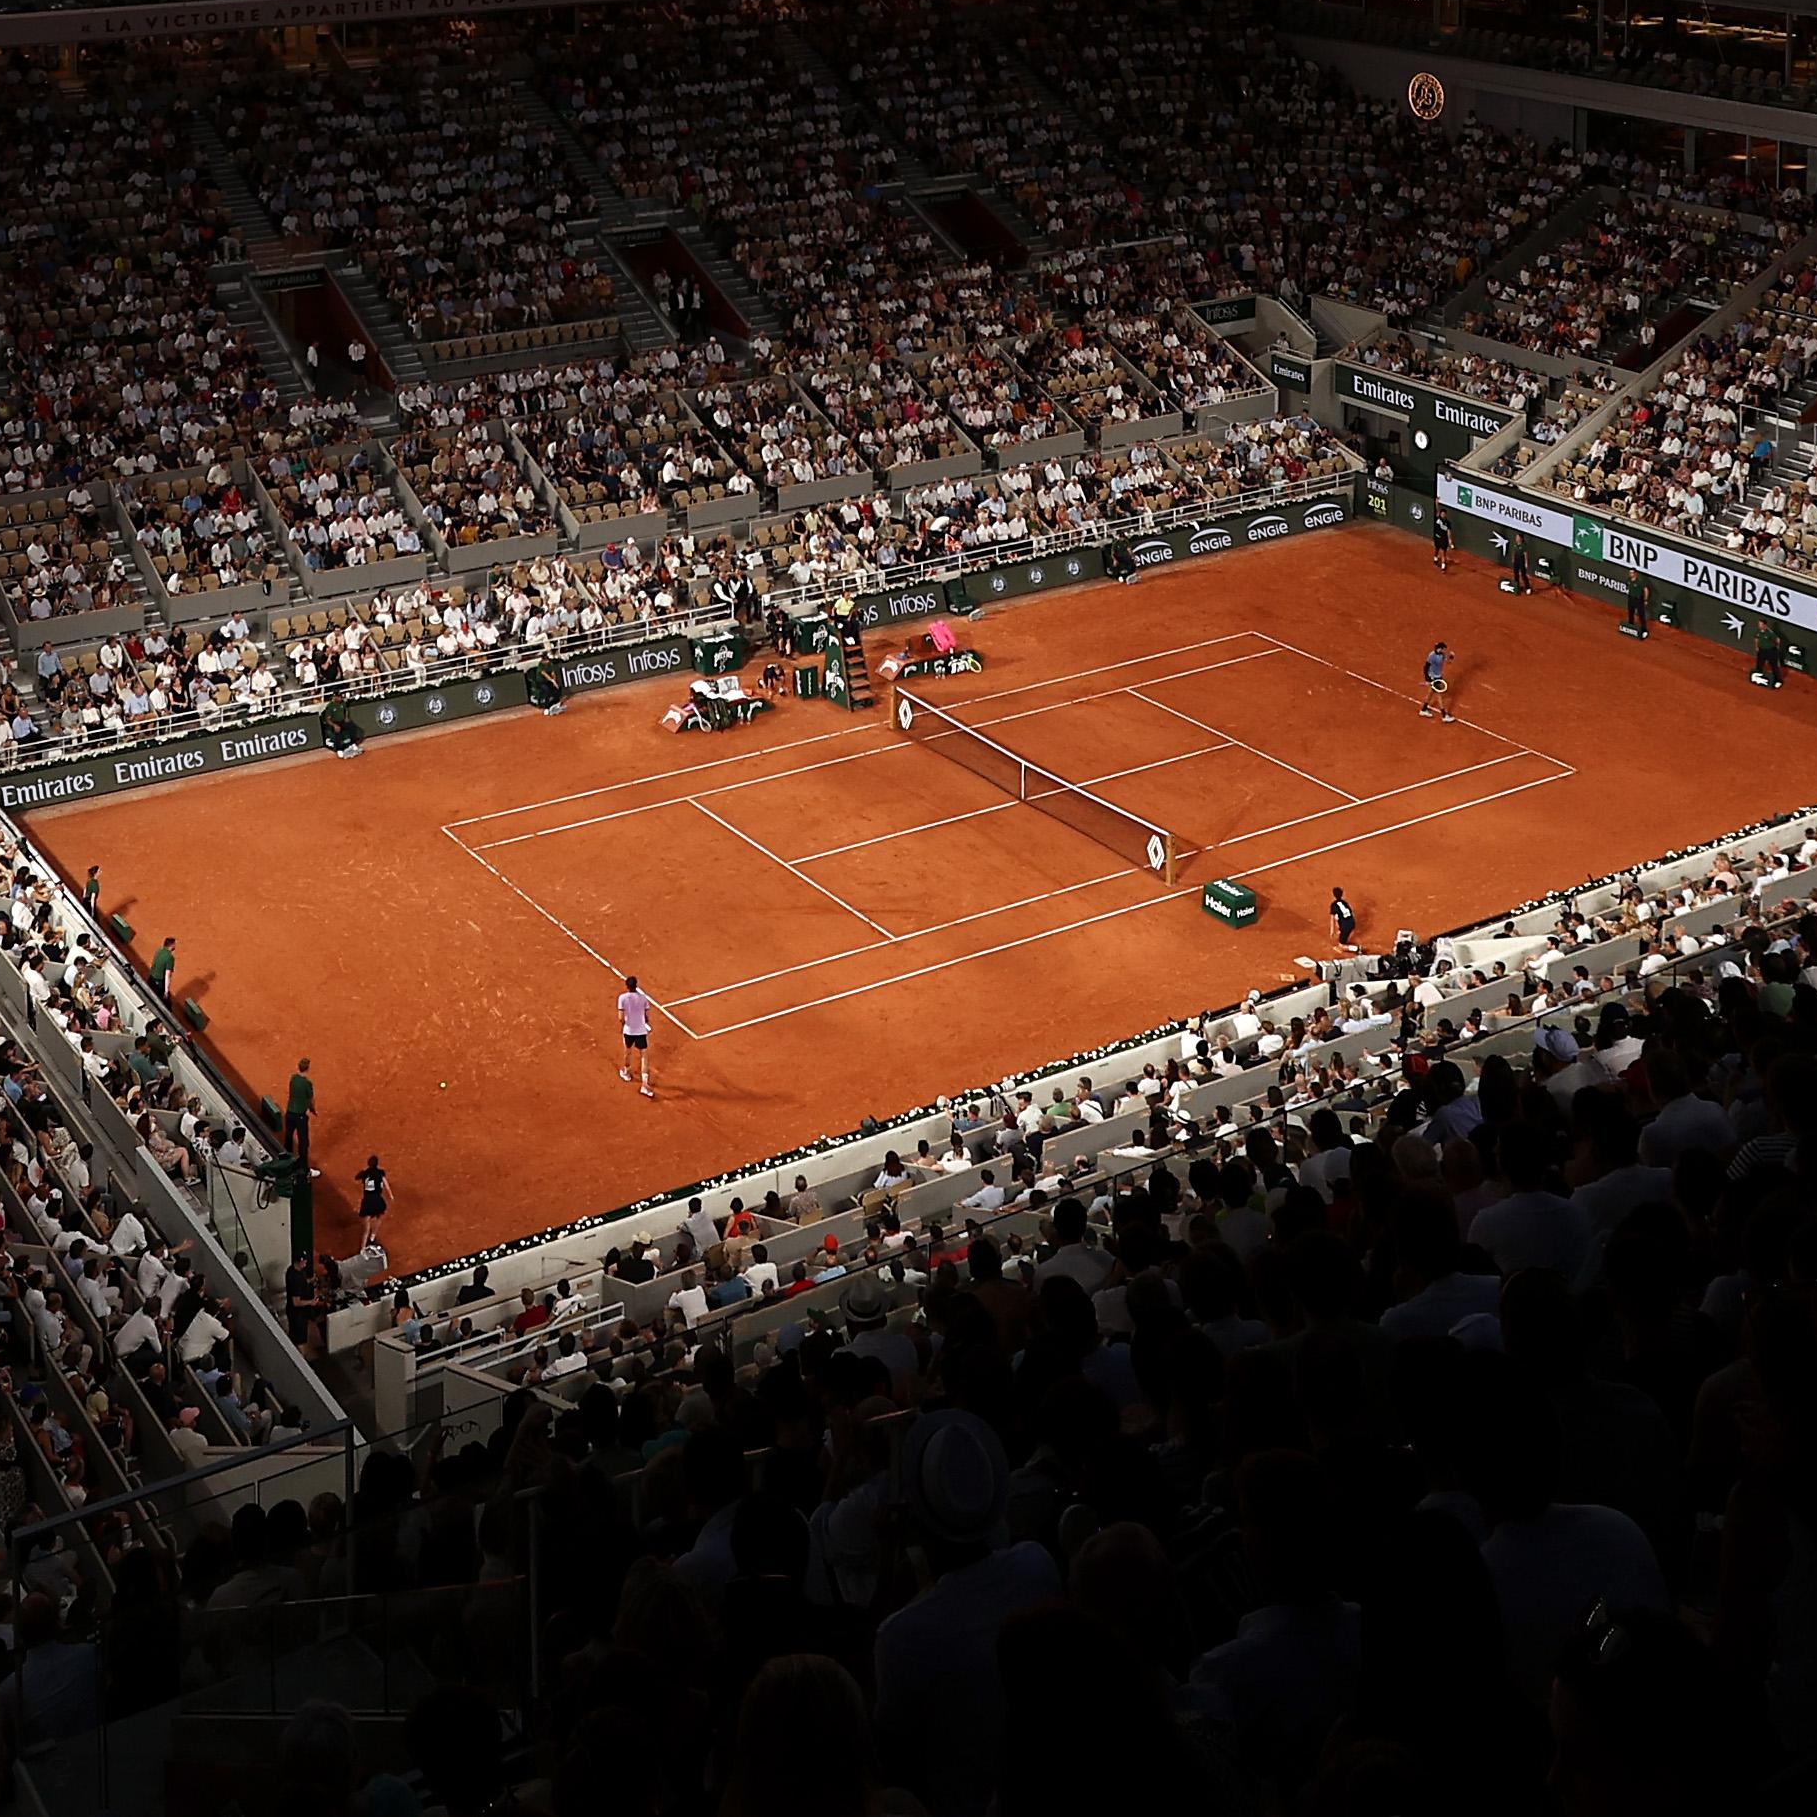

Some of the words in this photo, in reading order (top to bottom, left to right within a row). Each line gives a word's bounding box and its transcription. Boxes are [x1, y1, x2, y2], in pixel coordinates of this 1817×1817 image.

[105, 19, 132, 33] LA
[145, 9, 260, 28] VICTOIRE
[1273, 363, 1305, 382] Emirates
[1352, 374, 1416, 411] Emirates
[1434, 399, 1500, 434] Emirates
[1367, 494, 1388, 512] 201
[1474, 494, 1497, 512] BNP
[1498, 502, 1543, 529] PARIBAS
[1578, 567, 1598, 584] BNP
[1599, 574, 1629, 595] PARIB
[1609, 534, 1659, 571] BNP
[1683, 558, 1792, 617] PARIBAS
[888, 591, 937, 617] Infosys
[628, 646, 682, 674] Infosys
[561, 661, 616, 688] Infosys
[220, 727, 308, 762] Emirates
[114, 749, 205, 784] Emirates
[1, 771, 95, 808] Emirates
[1204, 894, 1232, 919] Haier
[1236, 905, 1256, 920] Haier
